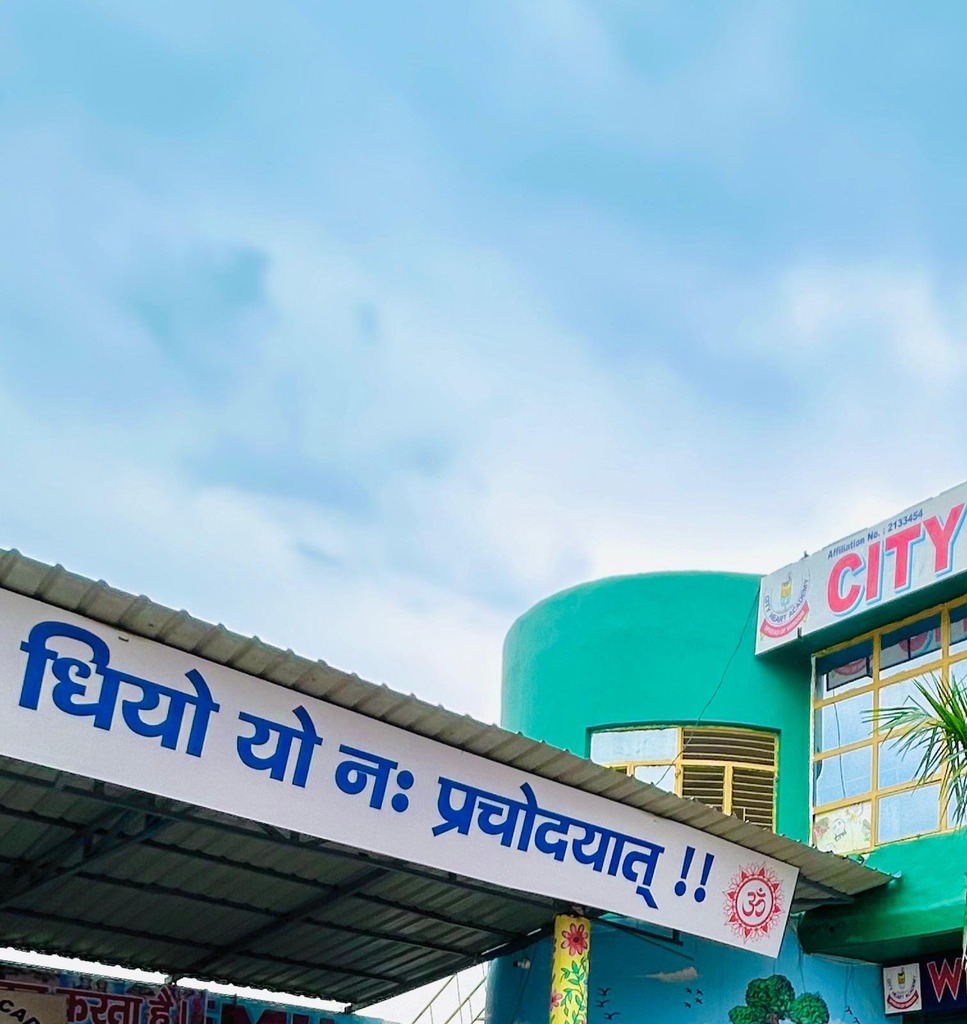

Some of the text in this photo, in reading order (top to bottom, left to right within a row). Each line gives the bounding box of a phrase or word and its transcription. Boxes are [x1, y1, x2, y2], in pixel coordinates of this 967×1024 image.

[827, 537, 866, 560] Affiliation
[867, 530, 881, 542] No.
[887, 508, 924, 532] 2133454
[17, 620, 221, 759] धियो
[235, 704, 324, 789] यो
[334, 743, 416, 814] नः
[431, 775, 666, 911] प्रचोदयात्
